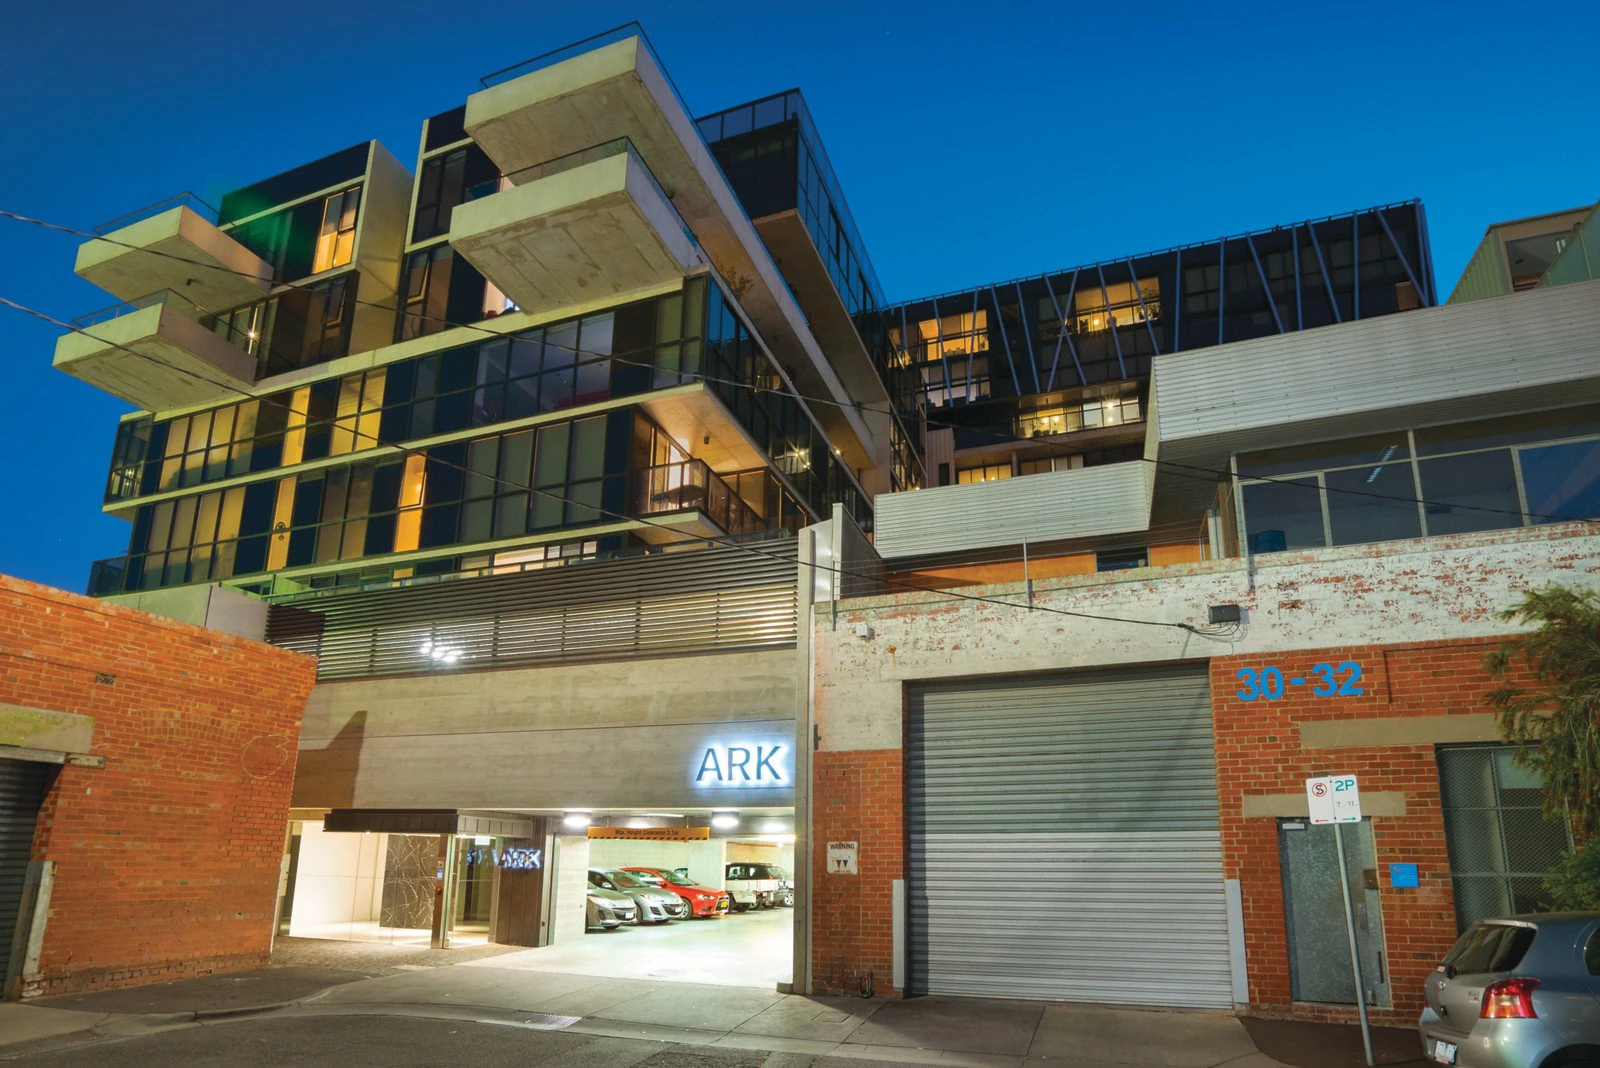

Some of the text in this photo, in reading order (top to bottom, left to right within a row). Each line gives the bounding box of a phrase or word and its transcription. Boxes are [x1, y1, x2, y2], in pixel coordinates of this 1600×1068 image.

[696, 746, 781, 781] ARK
[1334, 779, 1355, 792] 2P
[627, 829, 642, 837] Height
[642, 829, 666, 837] Clearance
